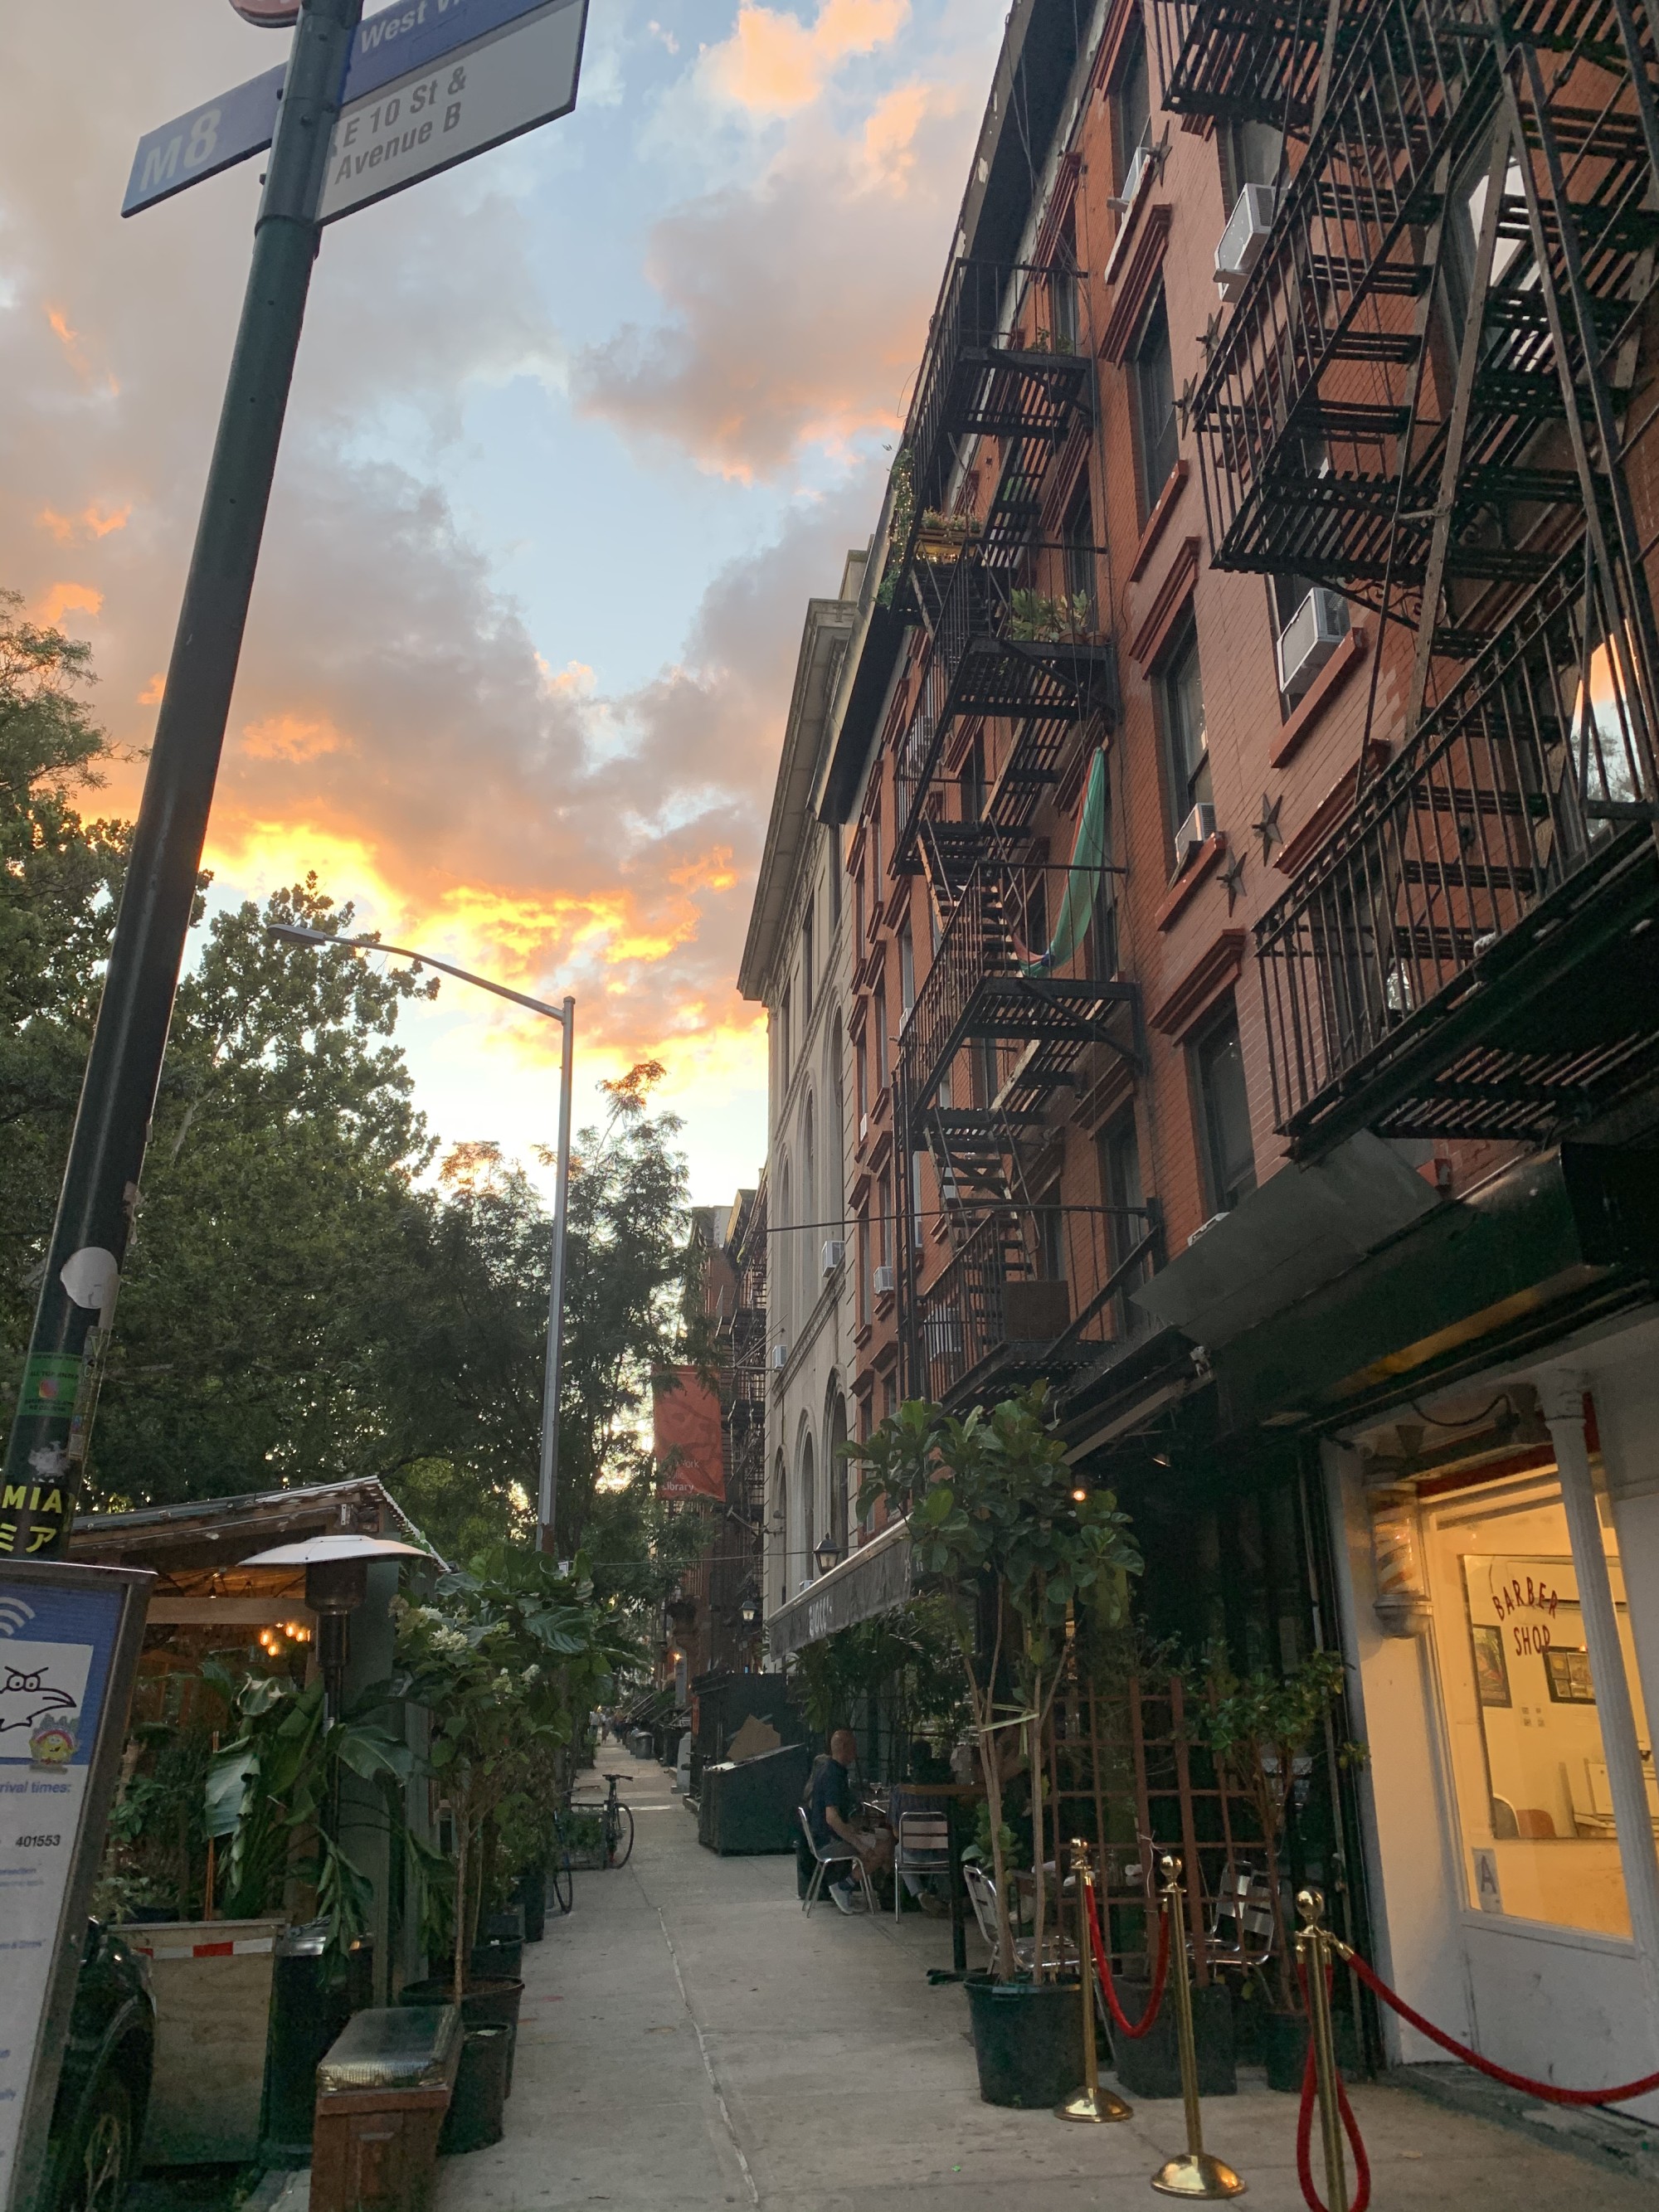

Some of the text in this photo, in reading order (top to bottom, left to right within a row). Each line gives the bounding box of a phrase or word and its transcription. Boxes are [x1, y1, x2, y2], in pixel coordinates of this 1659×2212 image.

[361, 2, 426, 54] West
[343, 66, 467, 148] E 10 St &
[139, 108, 222, 192] M8
[334, 101, 461, 185] Avenue B
[2, 1485, 62, 1514] MIA
[1492, 1577, 1558, 1621] BARBER
[1514, 1625, 1550, 1656] SHOP
[32, 1782, 71, 1793] times:
[16, 1835, 61, 1847] 401553
[1481, 1855, 1496, 1894] A
